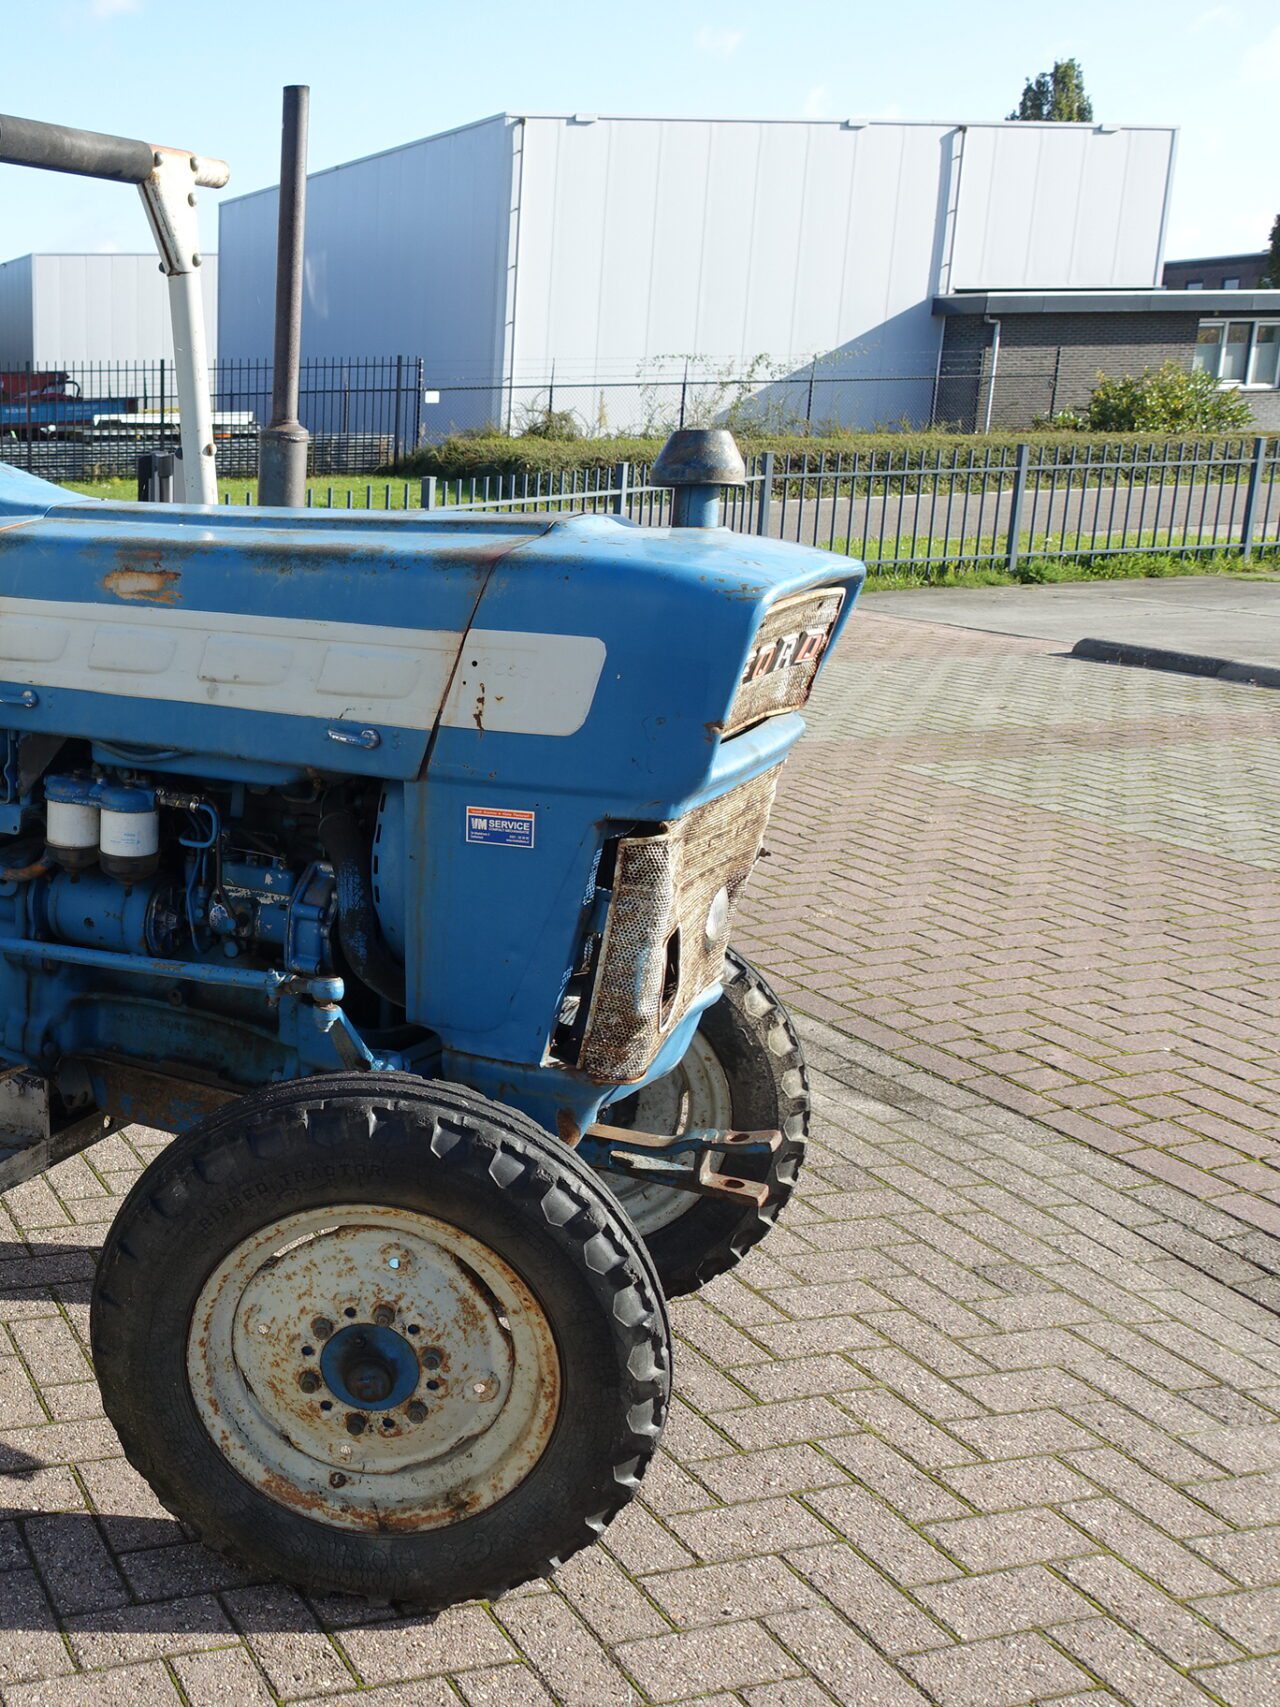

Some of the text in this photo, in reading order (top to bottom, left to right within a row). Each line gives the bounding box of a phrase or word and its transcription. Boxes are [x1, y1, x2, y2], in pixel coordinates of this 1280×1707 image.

[488, 819, 530, 831] SERVICE
[198, 1162, 390, 1231] RIBBED TRACTOR
